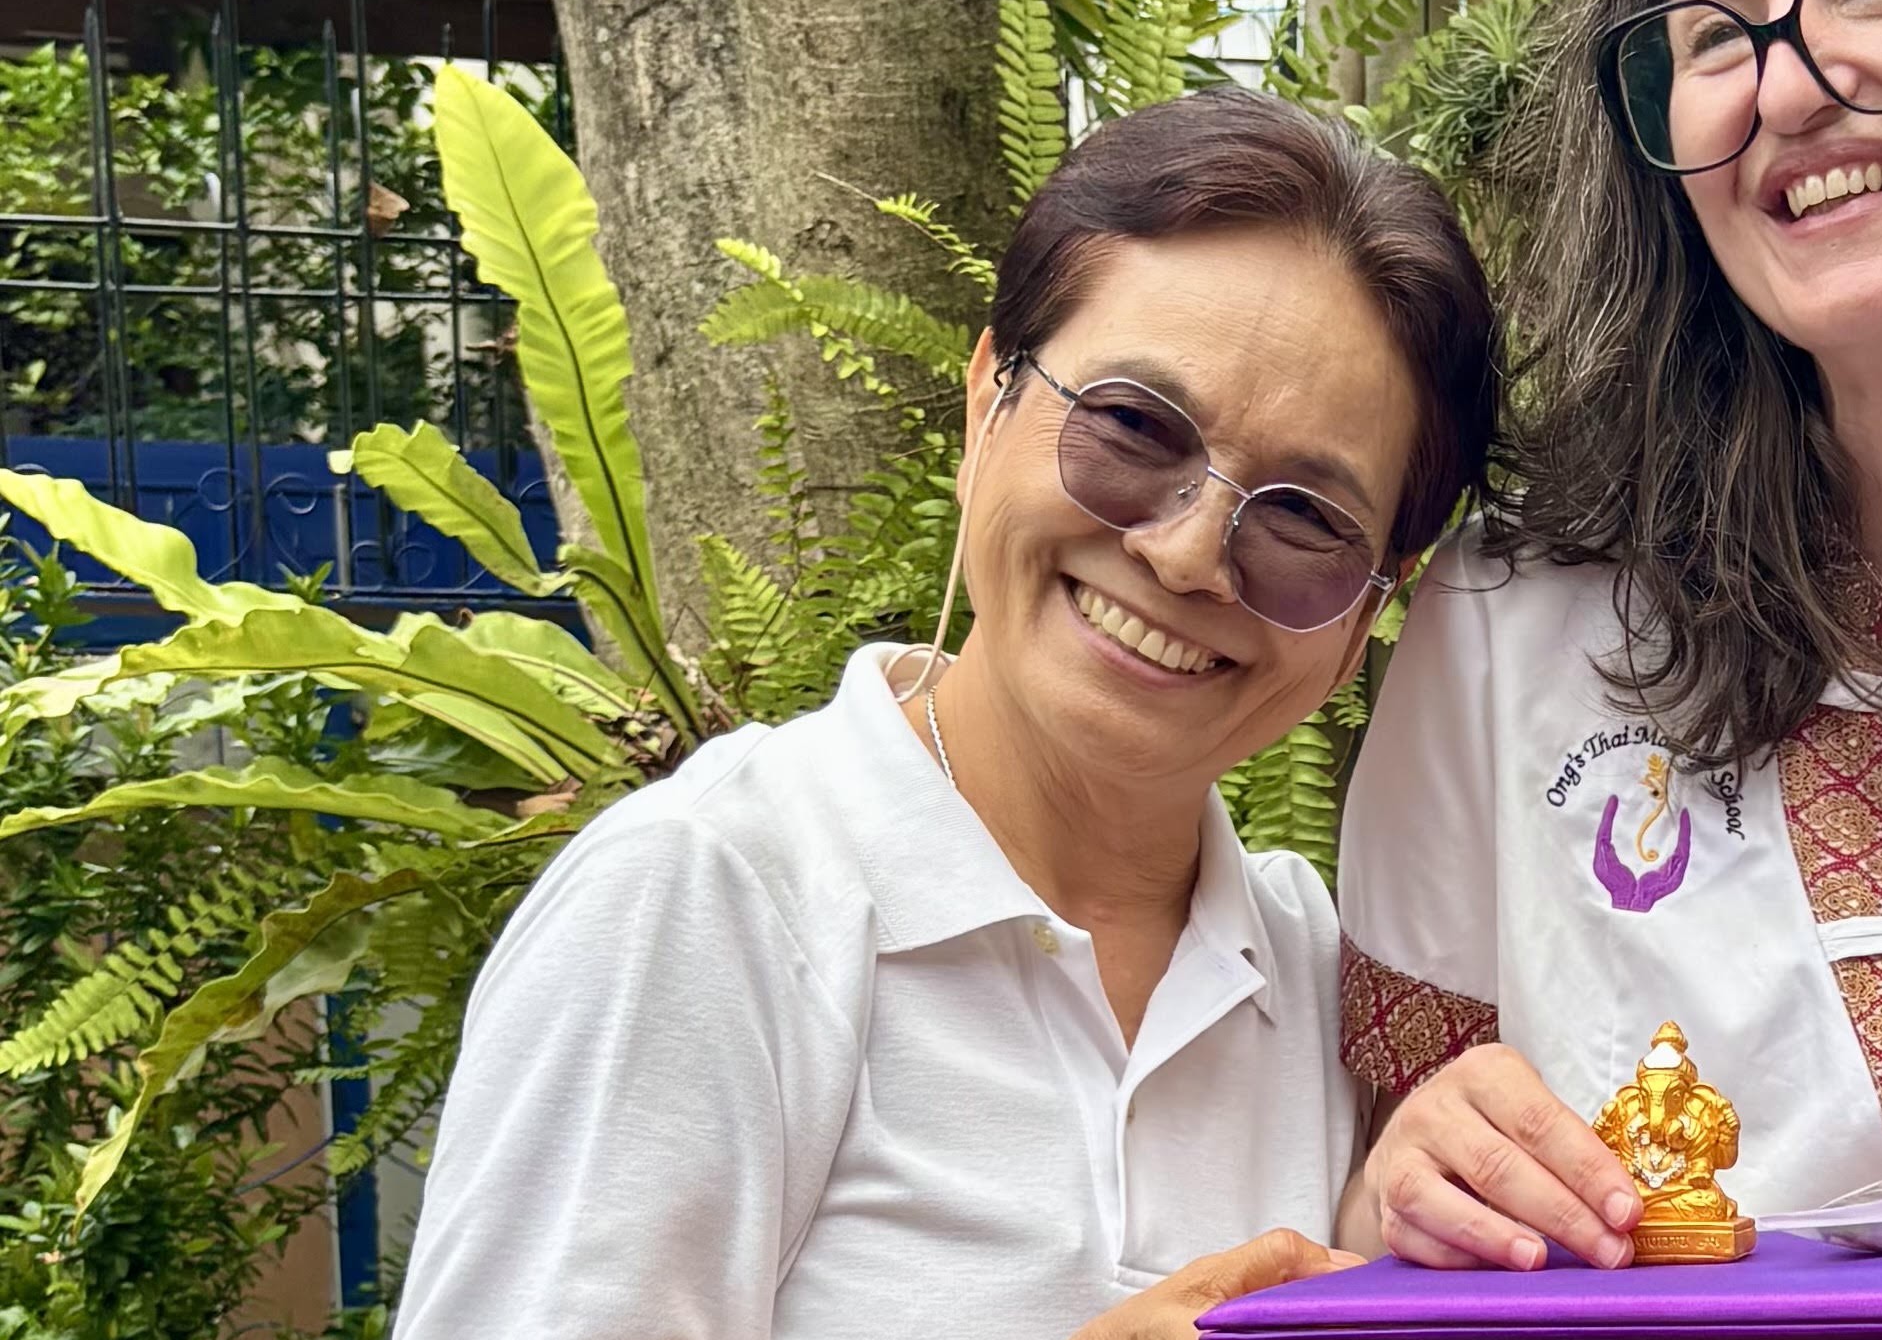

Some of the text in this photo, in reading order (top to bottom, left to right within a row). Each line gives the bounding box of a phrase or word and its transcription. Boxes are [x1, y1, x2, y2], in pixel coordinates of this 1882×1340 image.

[1546, 752, 1586, 808] Ong's
[1583, 725, 1629, 760] Thai
[1711, 771, 1746, 841] School
